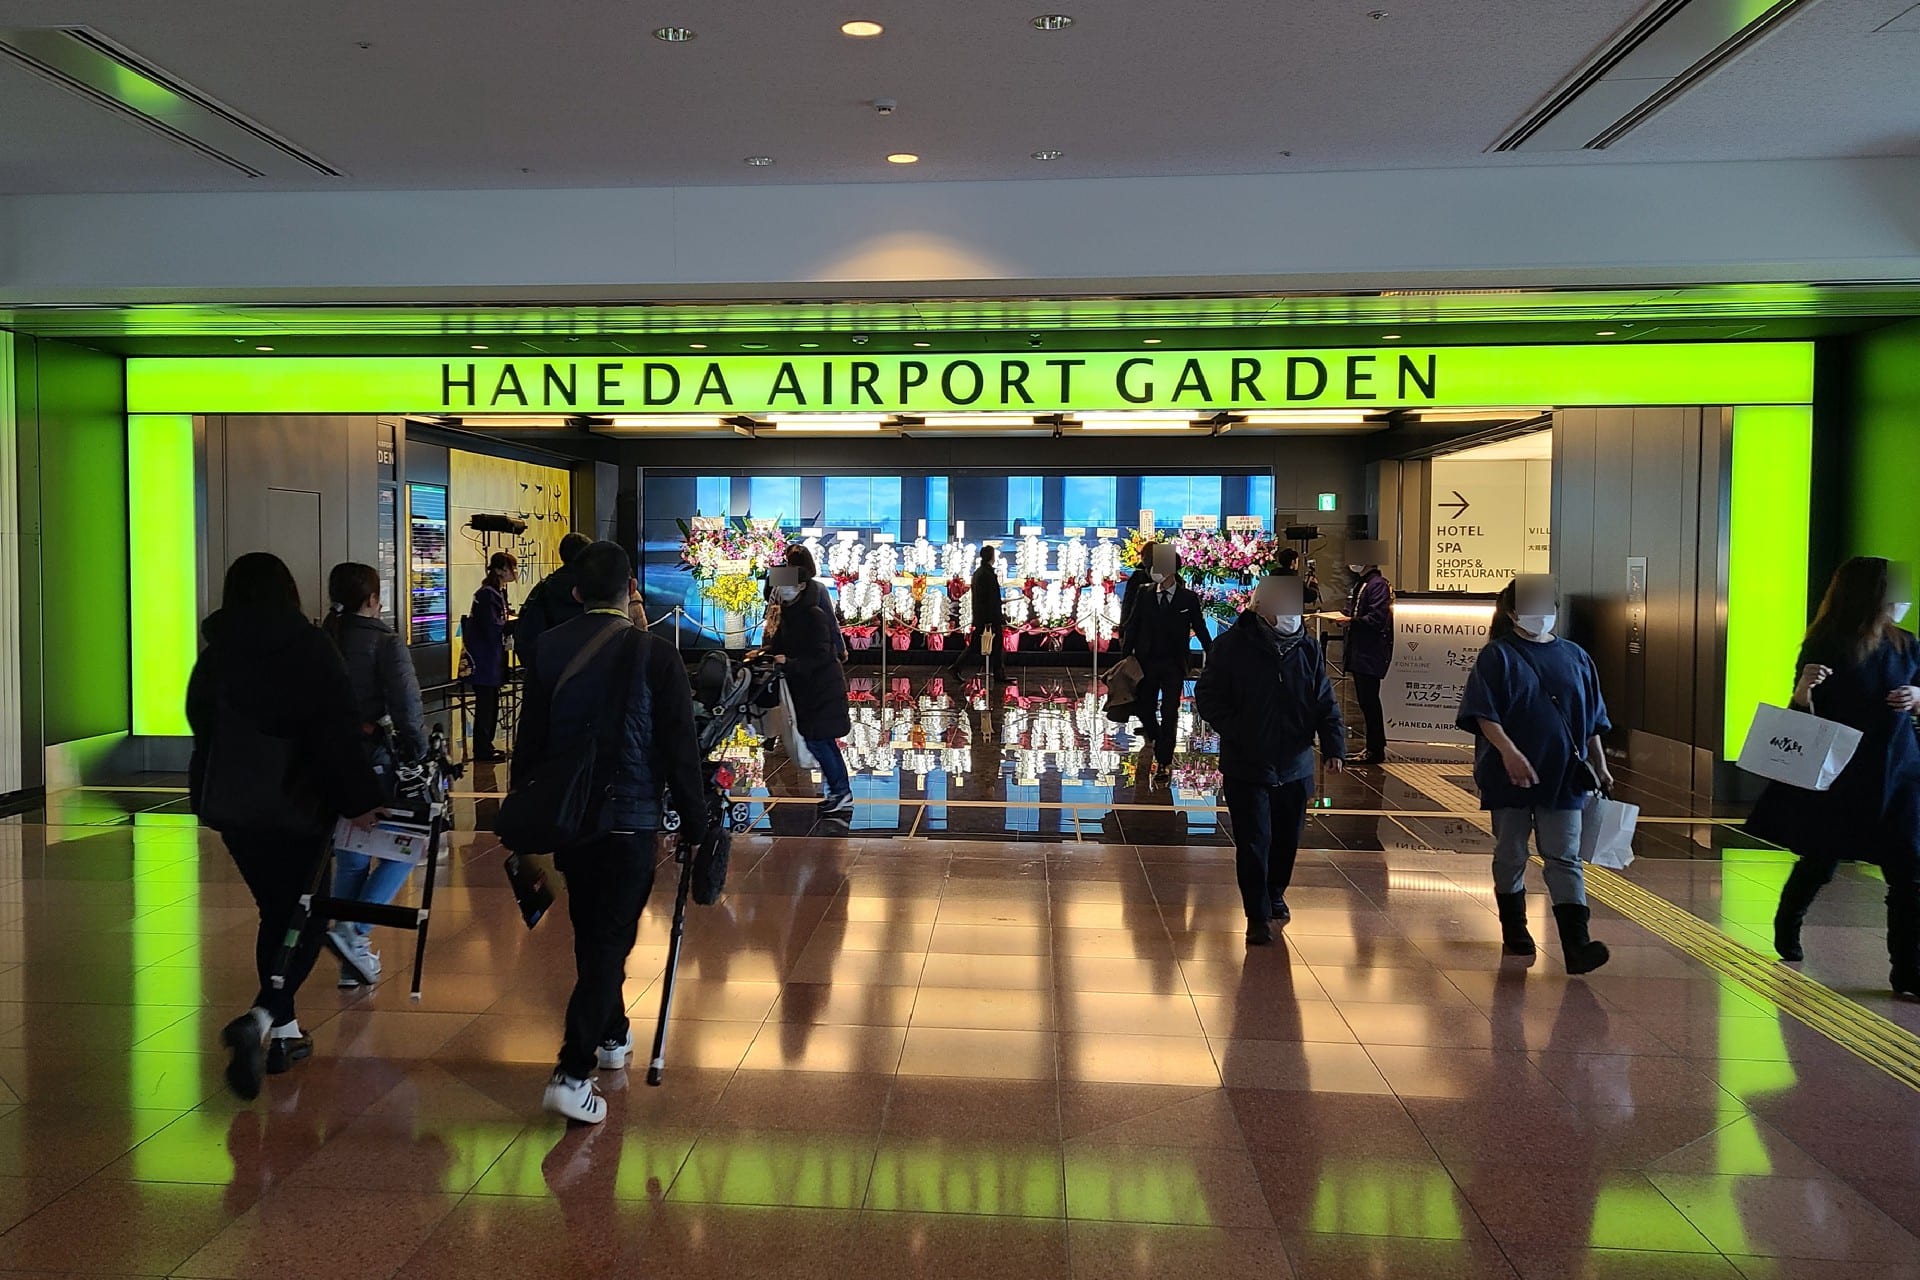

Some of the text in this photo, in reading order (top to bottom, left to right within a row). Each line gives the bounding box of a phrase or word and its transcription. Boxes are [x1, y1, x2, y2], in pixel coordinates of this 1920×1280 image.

[441, 354, 1436, 406] HANEDA AIRPORT GARDEN
[1437, 525, 1485, 536] HOTEL
[1437, 542, 1462, 553] SPA
[1436, 559, 1483, 568] SHOPS &
[1436, 569, 1516, 578] RESTAURANTS
[1398, 720, 1433, 729] HANEDA
